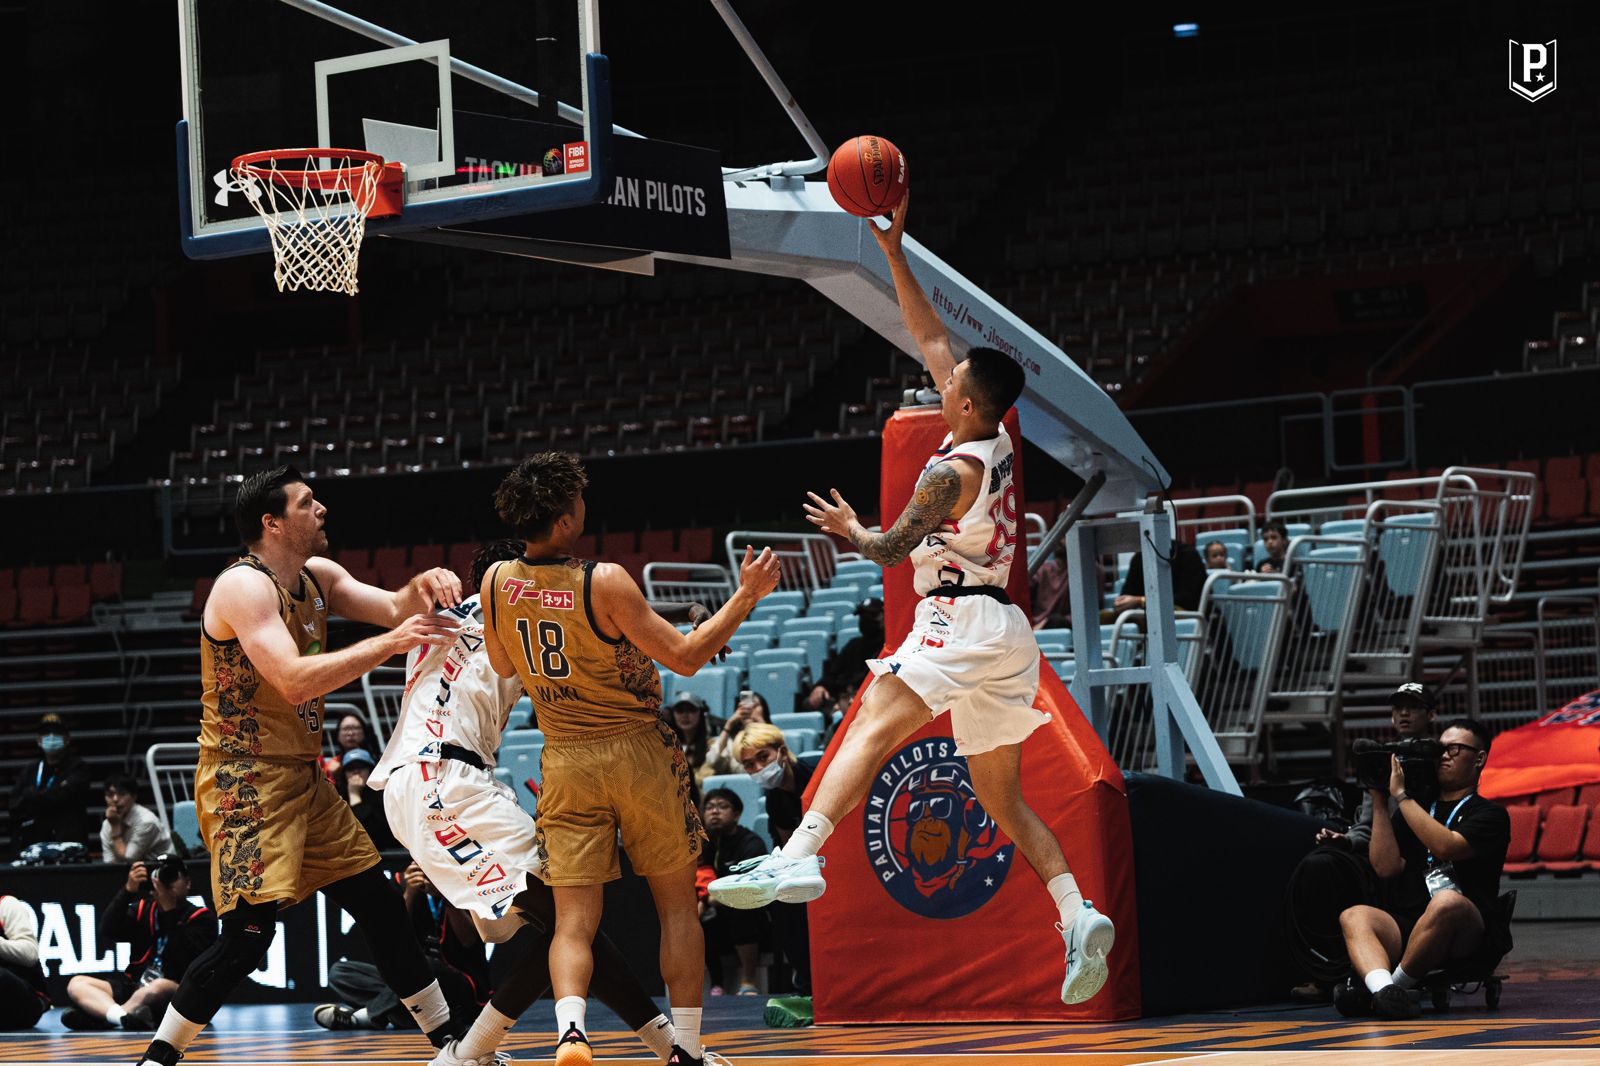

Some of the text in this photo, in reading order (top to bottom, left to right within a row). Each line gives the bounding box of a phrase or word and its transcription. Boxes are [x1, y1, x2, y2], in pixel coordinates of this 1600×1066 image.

[568, 145, 584, 157] FIBA
[646, 180, 706, 217] PILOTS
[515, 618, 572, 680] 18
[868, 742, 949, 882] PAUIAN PILOTS
